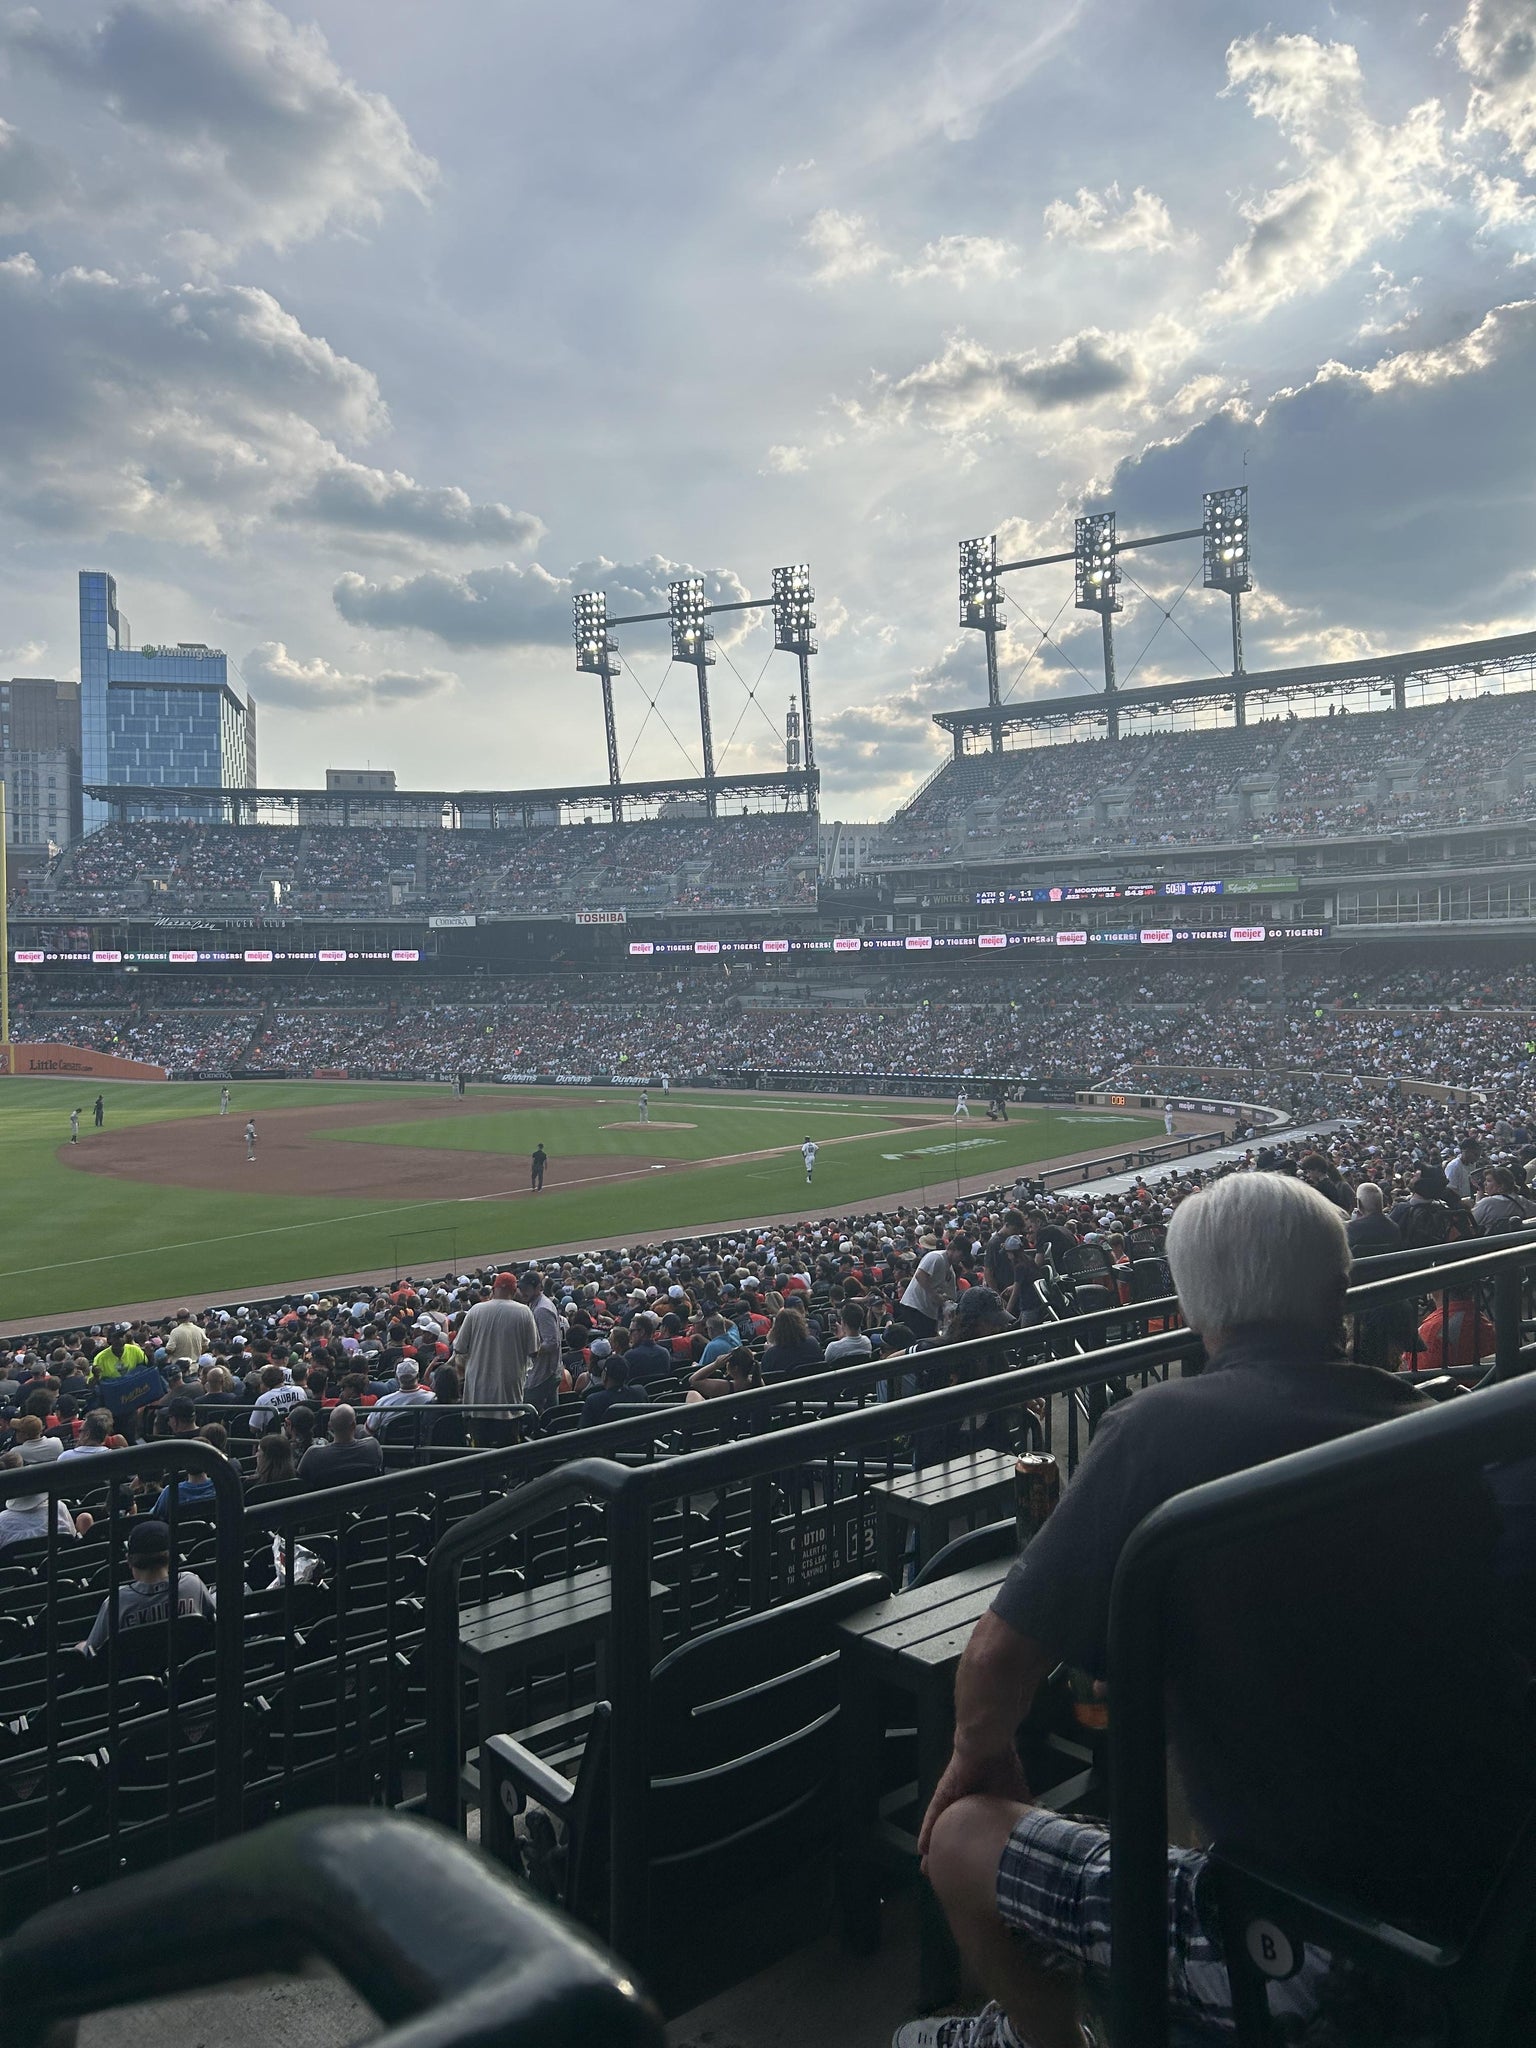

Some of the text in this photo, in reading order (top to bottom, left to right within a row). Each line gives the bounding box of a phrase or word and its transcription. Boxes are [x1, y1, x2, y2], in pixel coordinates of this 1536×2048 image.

[158, 644, 223, 661] Huntington
[577, 913, 625, 923] TOSHIBA
[225, 919, 254, 928] TIGER
[263, 919, 286, 928] CLUB
[1090, 933, 1138, 941] GO TIGERS!
[1143, 931, 1170, 942] meijer
[1191, 931, 1227, 939] TIGERS!
[1234, 929, 1262, 940] meijer
[1285, 929, 1323, 937] TIGERS!
[836, 940, 858, 950] meijer
[908, 938, 929, 948] meijer
[981, 936, 1004, 946] meijer
[631, 944, 652, 953] meijer
[697, 943, 718, 952] meijer
[765, 942, 786, 951] meijer
[17, 953, 42, 961] meijer
[95, 952, 119, 961] meijer
[172, 952, 195, 961] meijer
[247, 952, 270, 960] meijer
[321, 952, 344, 960] meijer
[394, 951, 417, 960] meijer
[29, 1059, 58, 1071] Little
[270, 1392, 300, 1407] SKUBAL
[803, 1544, 821, 1558] ALERT
[1261, 1933, 1277, 1960] B
